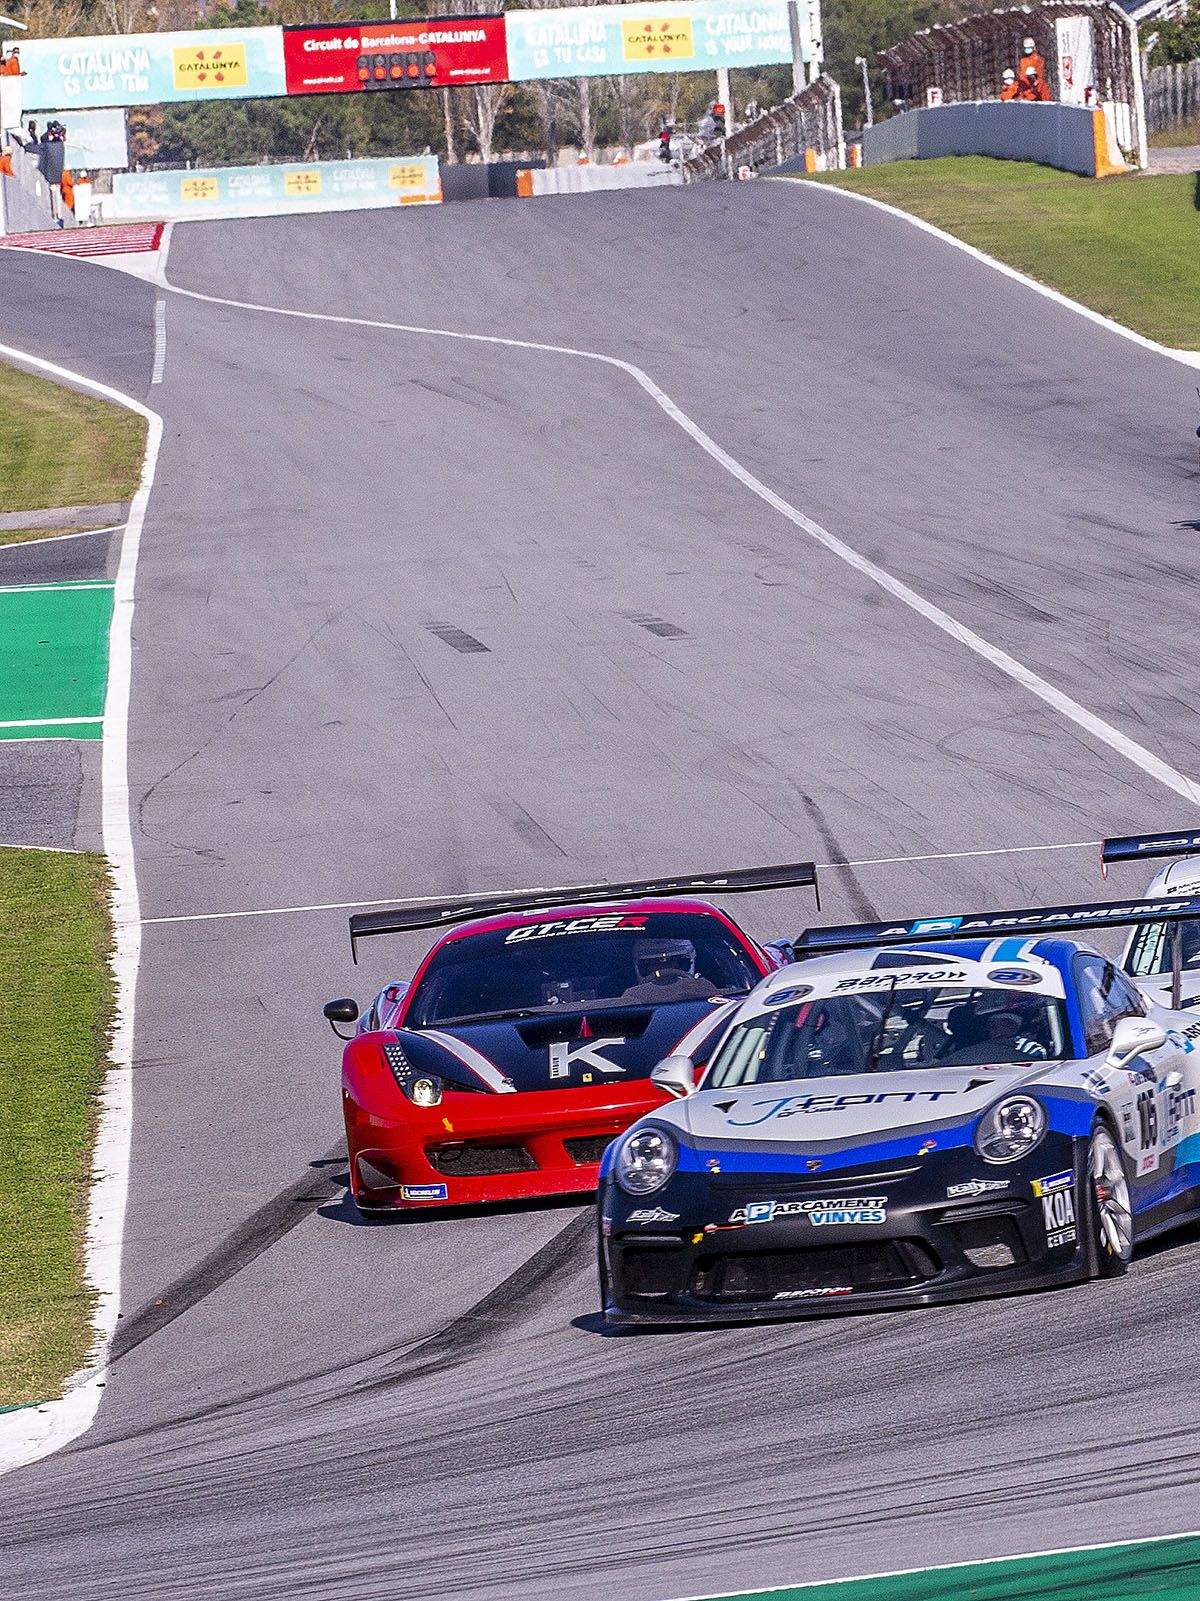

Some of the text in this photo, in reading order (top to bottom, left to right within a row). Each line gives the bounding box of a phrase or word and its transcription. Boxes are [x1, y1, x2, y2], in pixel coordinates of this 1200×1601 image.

[179, 61, 241, 72] CATALUNYA
[549, 1037, 627, 1080] K
[811, 1210, 886, 1226] VINYES
